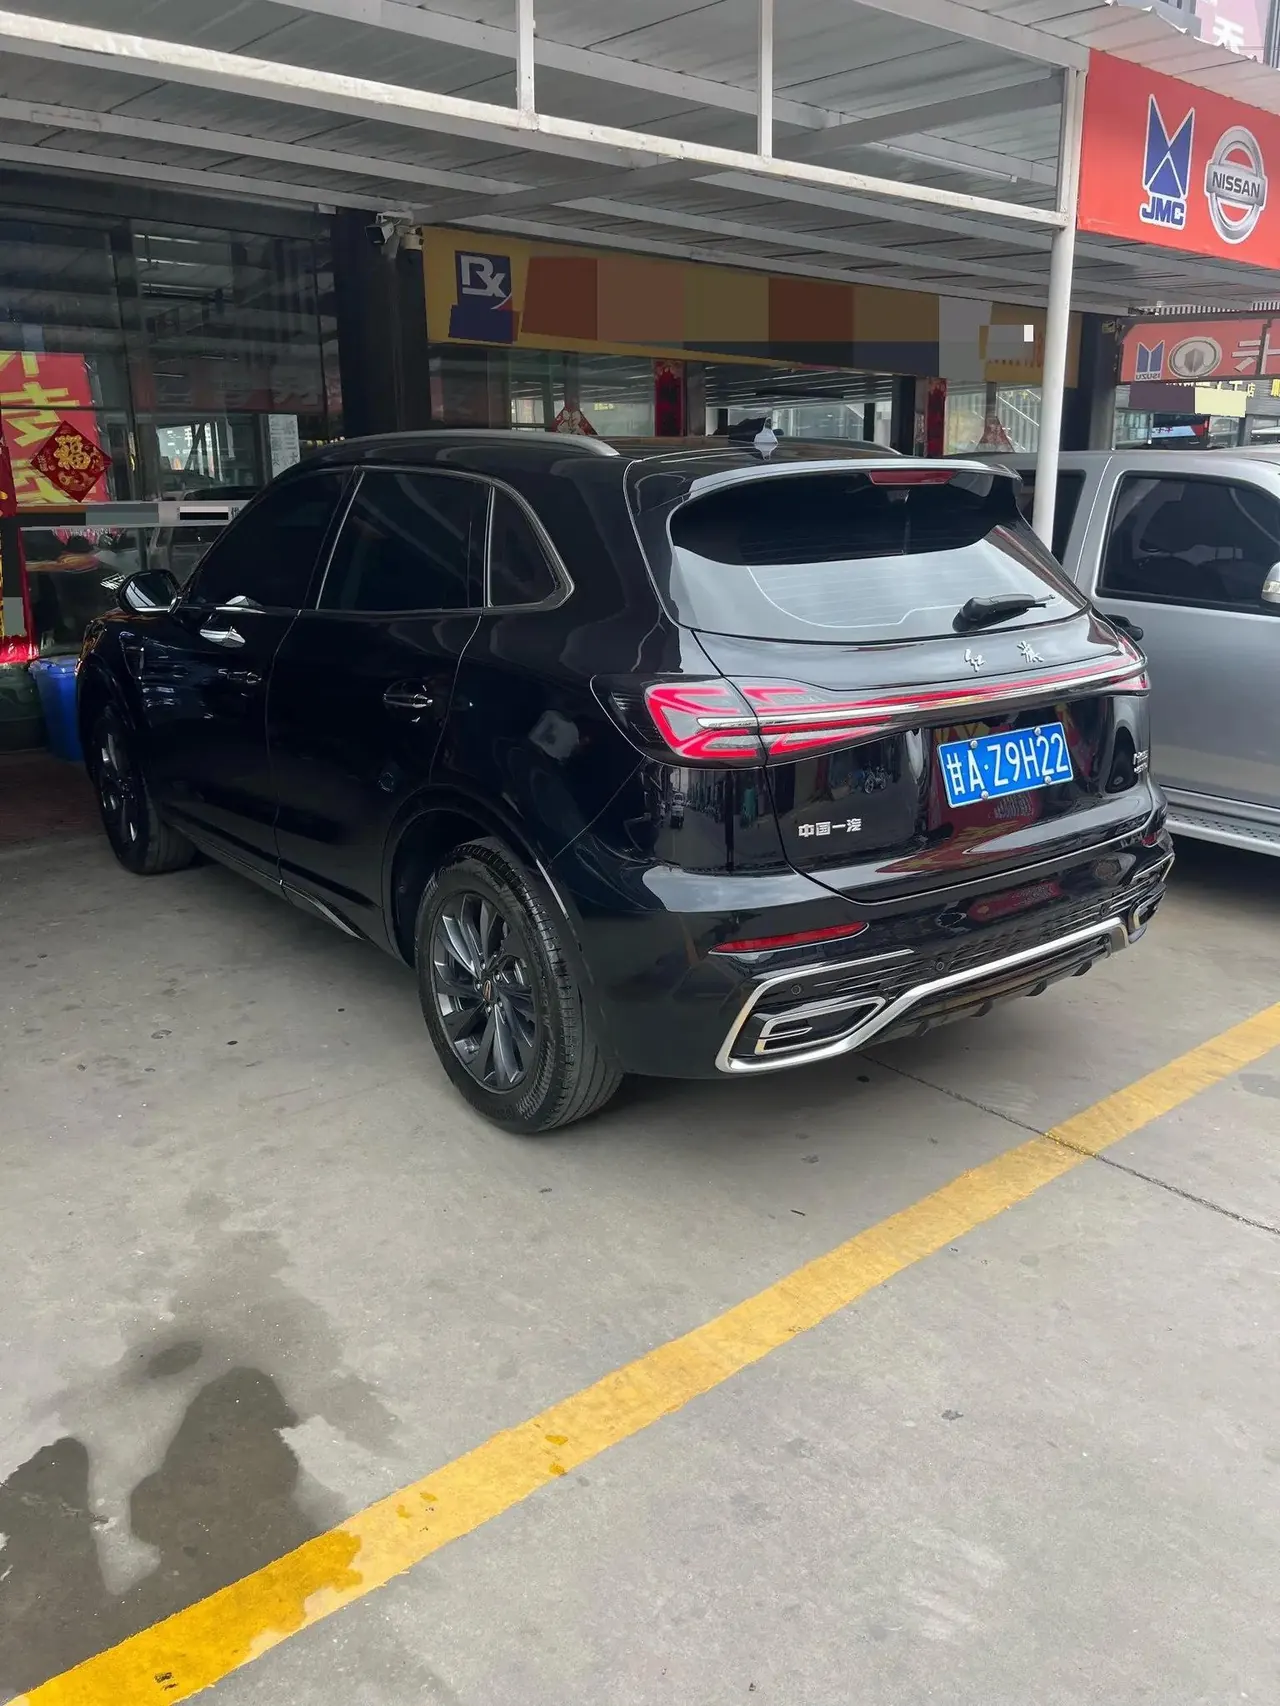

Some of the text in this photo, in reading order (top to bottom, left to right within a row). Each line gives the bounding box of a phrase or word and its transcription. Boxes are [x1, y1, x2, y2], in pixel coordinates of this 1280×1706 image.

[1212, 171, 1260, 198] NISSAN
[1141, 196, 1185, 226] JMC
[798, 818, 861, 837] 中国一汽
